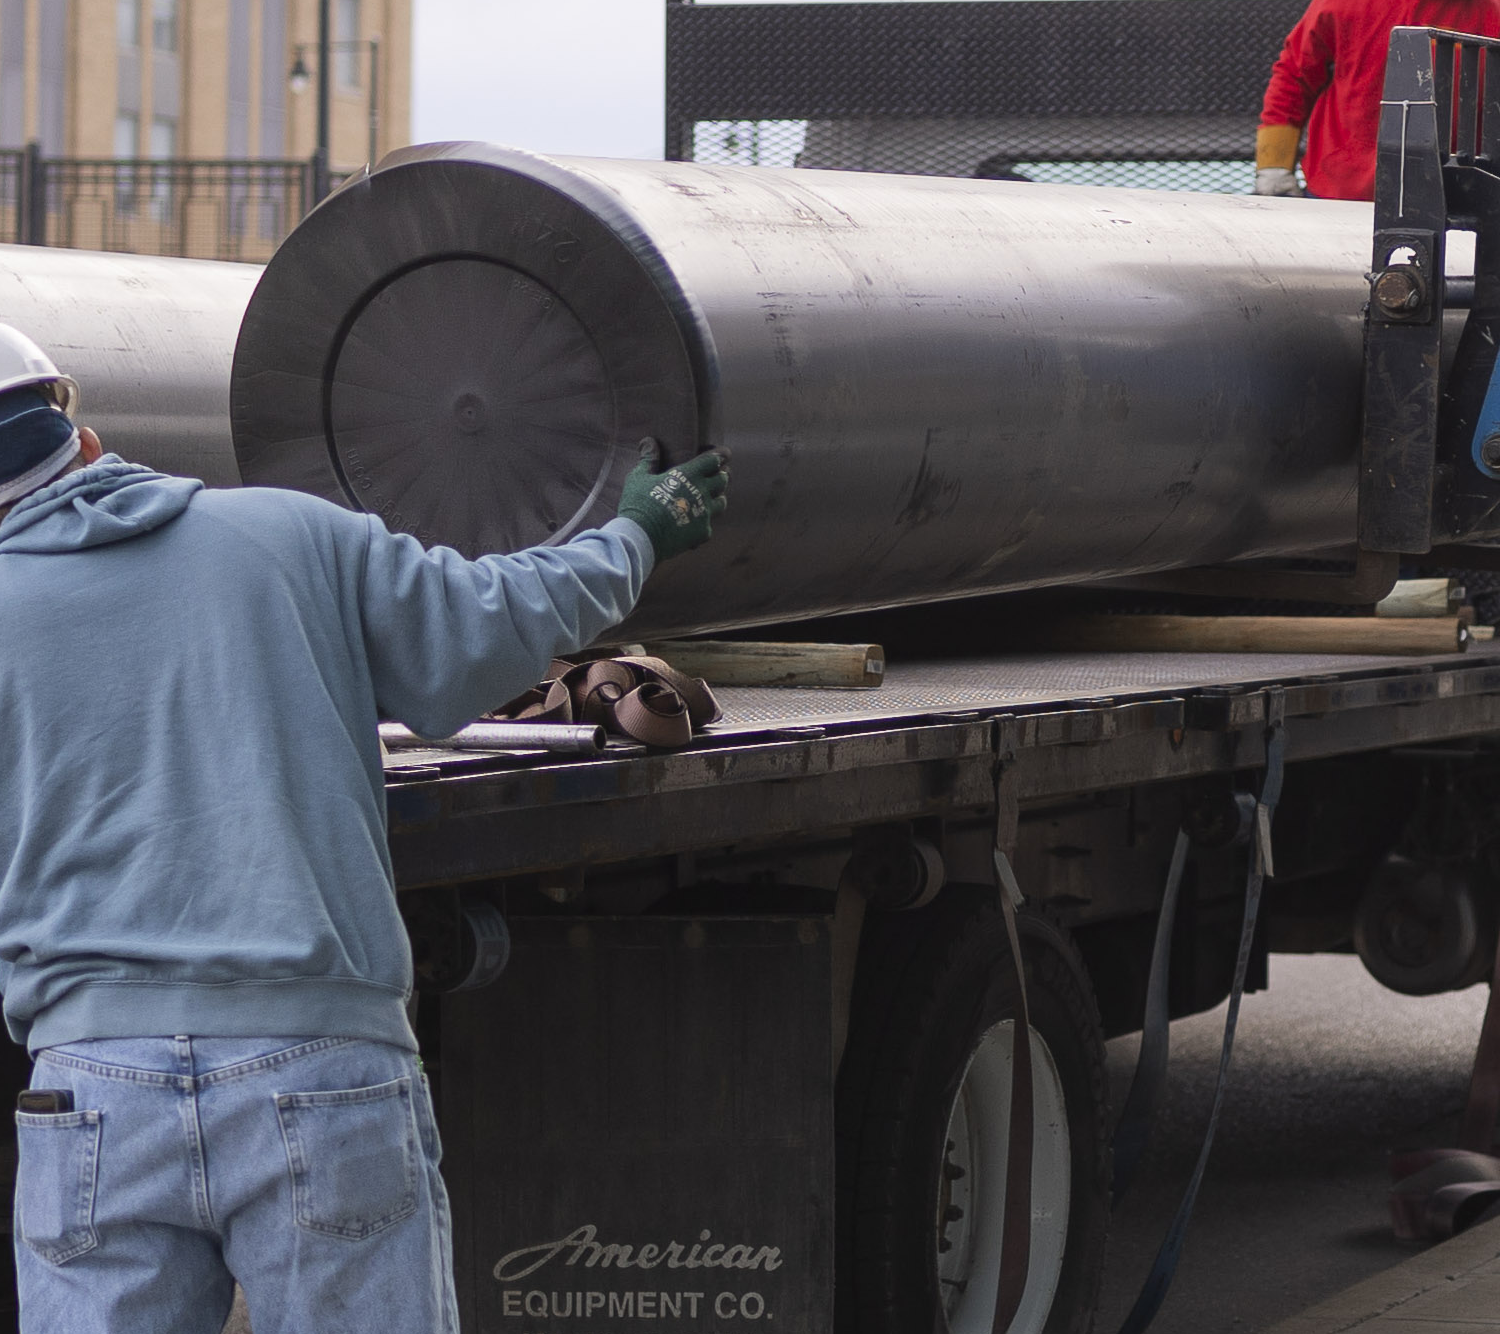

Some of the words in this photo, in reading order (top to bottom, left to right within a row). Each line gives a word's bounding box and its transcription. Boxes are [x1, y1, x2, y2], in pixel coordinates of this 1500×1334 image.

[493, 1224, 784, 1282] American
[502, 1290, 705, 1319] EQUIPMENT
[714, 1291, 774, 1320] CO.
